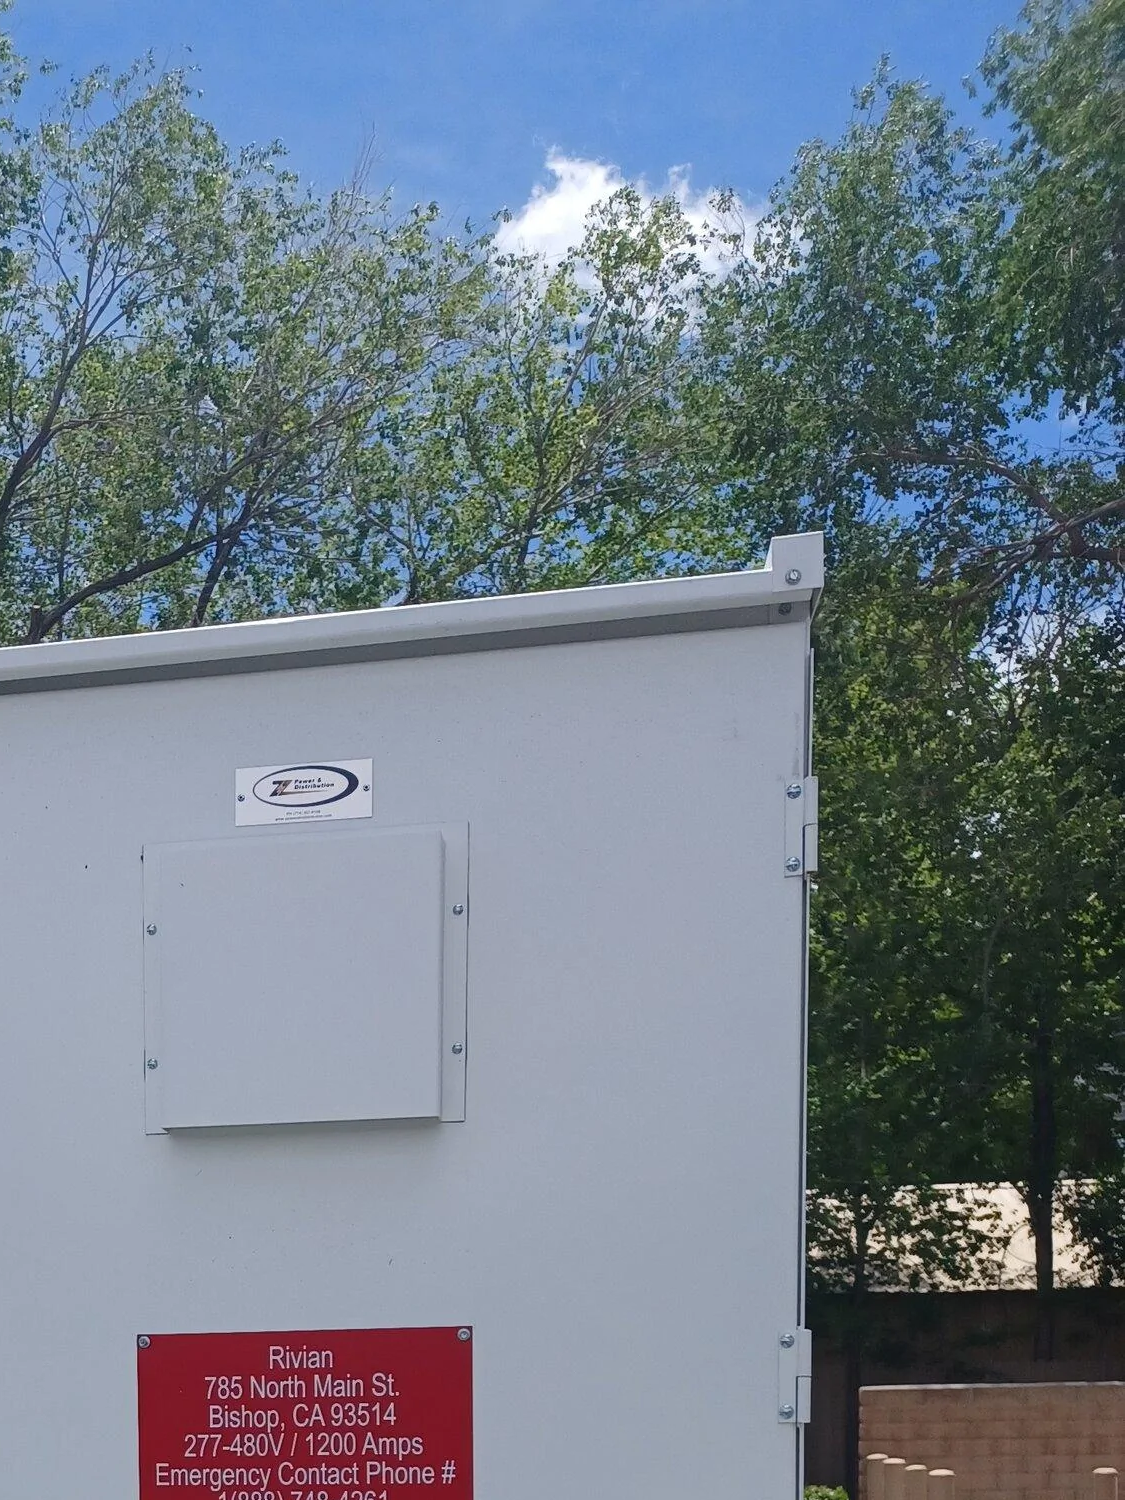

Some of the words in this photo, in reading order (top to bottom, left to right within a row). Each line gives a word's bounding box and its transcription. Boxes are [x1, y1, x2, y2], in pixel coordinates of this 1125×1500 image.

[269, 1345, 334, 1369] Rivian
[204, 1375, 243, 1400] 785
[250, 1373, 306, 1399] North
[313, 1373, 364, 1398] Main
[371, 1372, 400, 1397] St.
[209, 1404, 286, 1432] Bishop,
[292, 1403, 326, 1428] CA
[330, 1402, 397, 1427] 93514
[184, 1433, 285, 1458] 277-480V
[290, 1432, 298, 1457] /
[305, 1431, 357, 1456] 1200
[361, 1431, 424, 1461] Amps
[155, 1462, 272, 1492] Emergency
[277, 1461, 360, 1486] Contact
[366, 1460, 435, 1485] Phone
[441, 1459, 456, 1485] #
